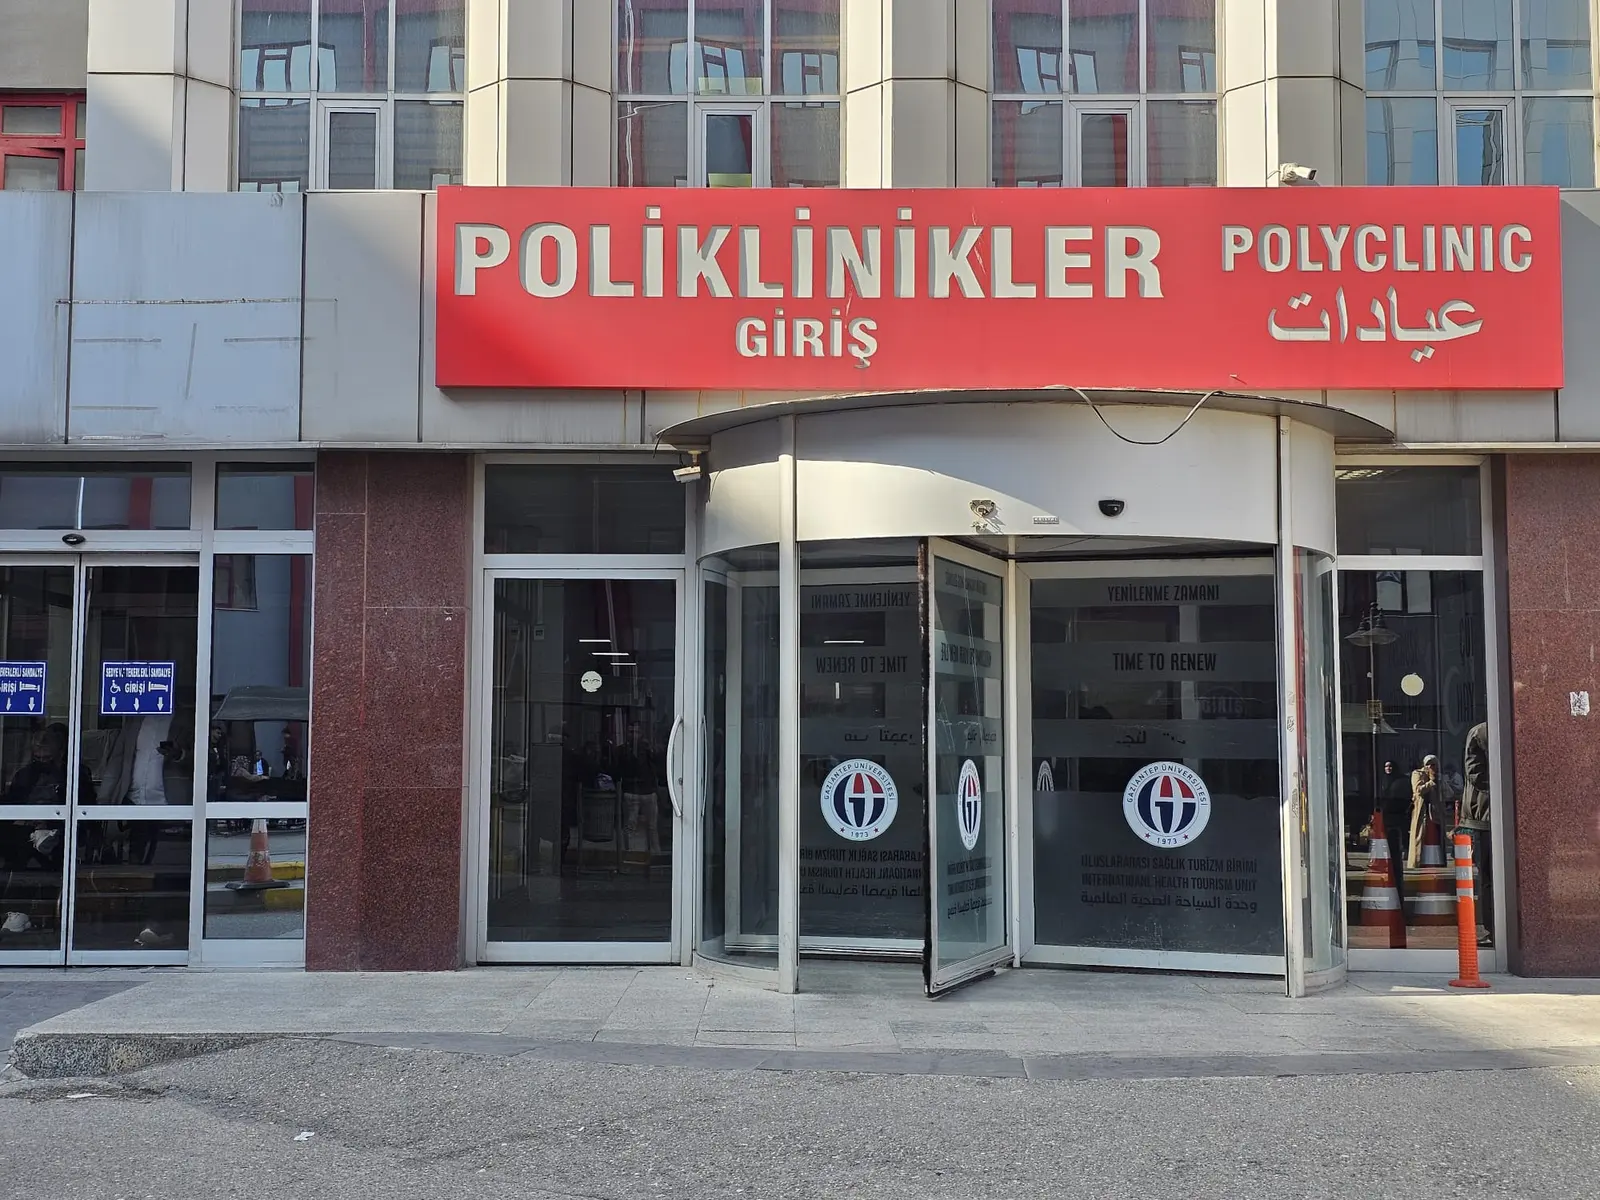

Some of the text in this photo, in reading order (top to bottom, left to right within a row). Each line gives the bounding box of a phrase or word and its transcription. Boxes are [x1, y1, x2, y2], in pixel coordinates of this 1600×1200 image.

[454, 205, 1164, 300] POLİKLİNİKLER
[1222, 223, 1534, 273] POLYCLINIC
[1267, 285, 1485, 363] عيادات
[735, 307, 879, 369] GİRİŞ
[1108, 583, 1220, 602] YENİLENME ZAMANI
[1112, 653, 1217, 671] TIME TO RENEW
[0, 680, 17, 696] İRİŞİ
[124, 680, 146, 696] GİRİŞİ
[1157, 837, 1177, 845] 1973
[1187, 857, 1223, 873] TURİZM
[1226, 858, 1257, 874] BİRİMİ
[1154, 875, 1189, 889] HEALTH
[1190, 876, 1233, 891] TOURISM
[1235, 878, 1257, 892] UNIT
[1225, 896, 1258, 914] وحدة
